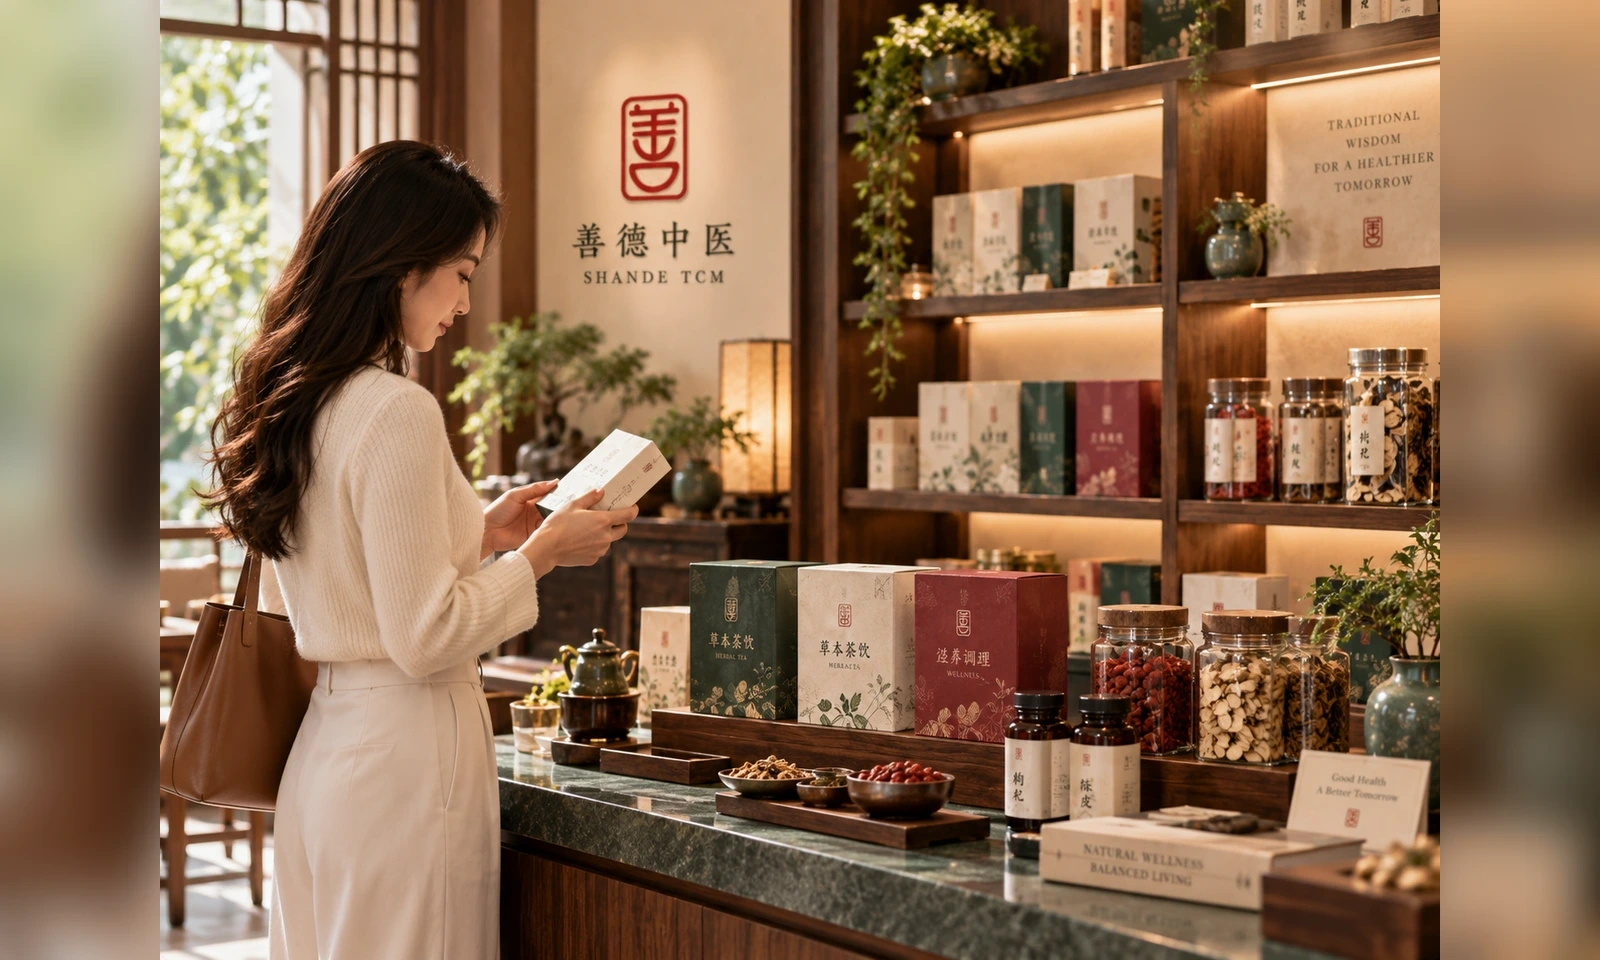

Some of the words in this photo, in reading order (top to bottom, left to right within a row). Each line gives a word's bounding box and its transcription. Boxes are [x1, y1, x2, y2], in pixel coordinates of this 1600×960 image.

[1327, 110, 1420, 131] TRADITIONAL
[1346, 133, 1401, 150] WISDOM
[1314, 161, 1339, 174] FOR
[1344, 159, 1353, 171] A
[1357, 151, 1435, 170] HEALTHIER
[1335, 175, 1413, 193] TOMORROW
[572, 220, 735, 260] 善德中医
[583, 270, 669, 285] SHANDE
[681, 269, 725, 284] TCM
[818, 639, 871, 659] 草本茶饮
[1331, 773, 1355, 784] Good
[1357, 775, 1387, 787] Health
[1316, 786, 1324, 795] A
[1325, 786, 1352, 798] Better
[1354, 789, 1399, 802] Tomorrow
[1083, 843, 1138, 862] NATURAL
[1142, 851, 1204, 871] WELLNESS
[1090, 861, 1149, 881] BALANCED
[1151, 869, 1193, 887] LIVING
